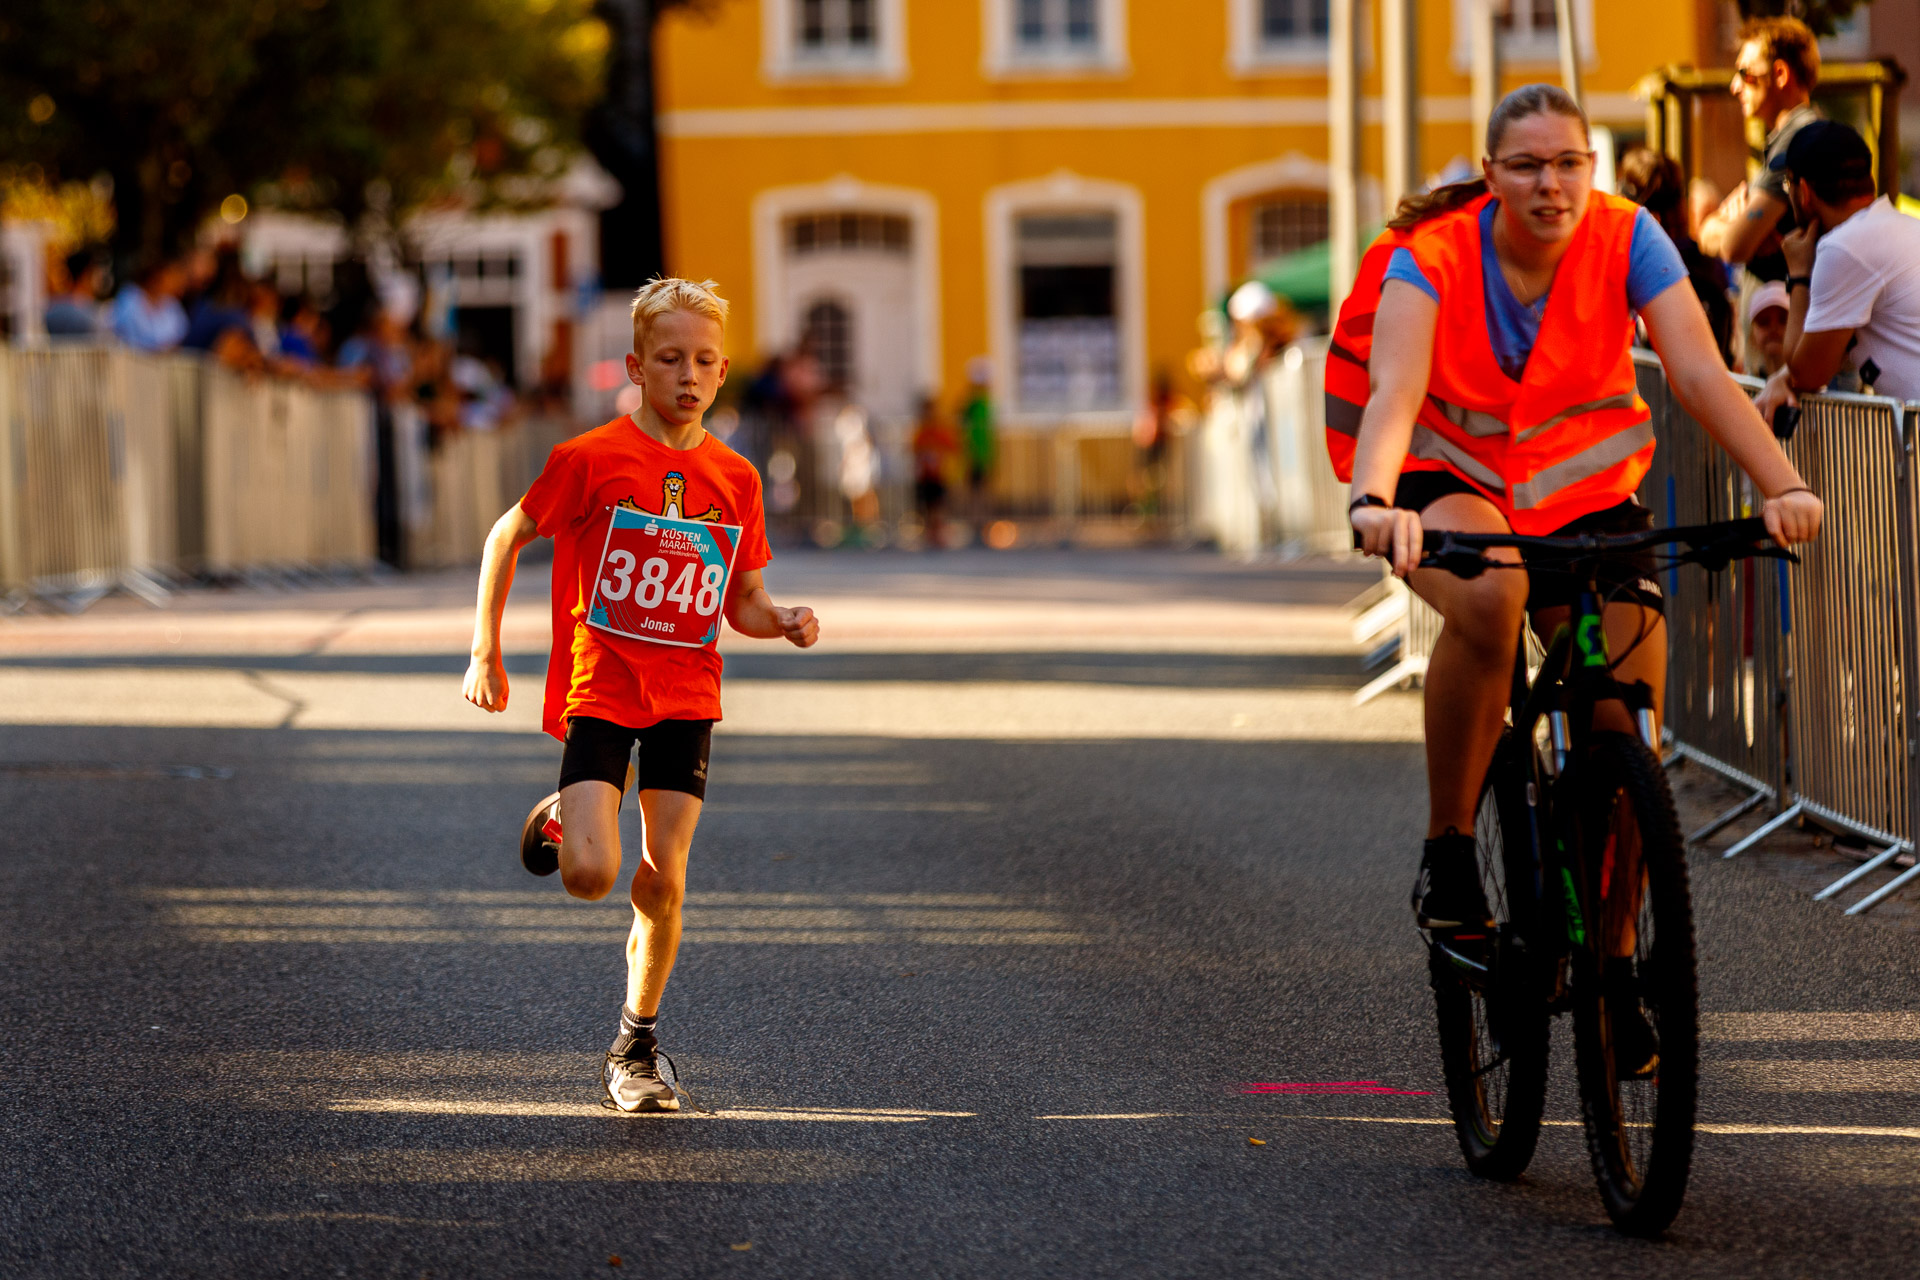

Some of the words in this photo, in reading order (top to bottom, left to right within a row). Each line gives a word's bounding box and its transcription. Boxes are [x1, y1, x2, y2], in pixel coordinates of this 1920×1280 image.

[661, 528, 701, 542] KÜSTEN
[659, 539, 710, 553] MARATHON
[601, 549, 724, 616] 3848
[640, 617, 676, 633] Jonas
